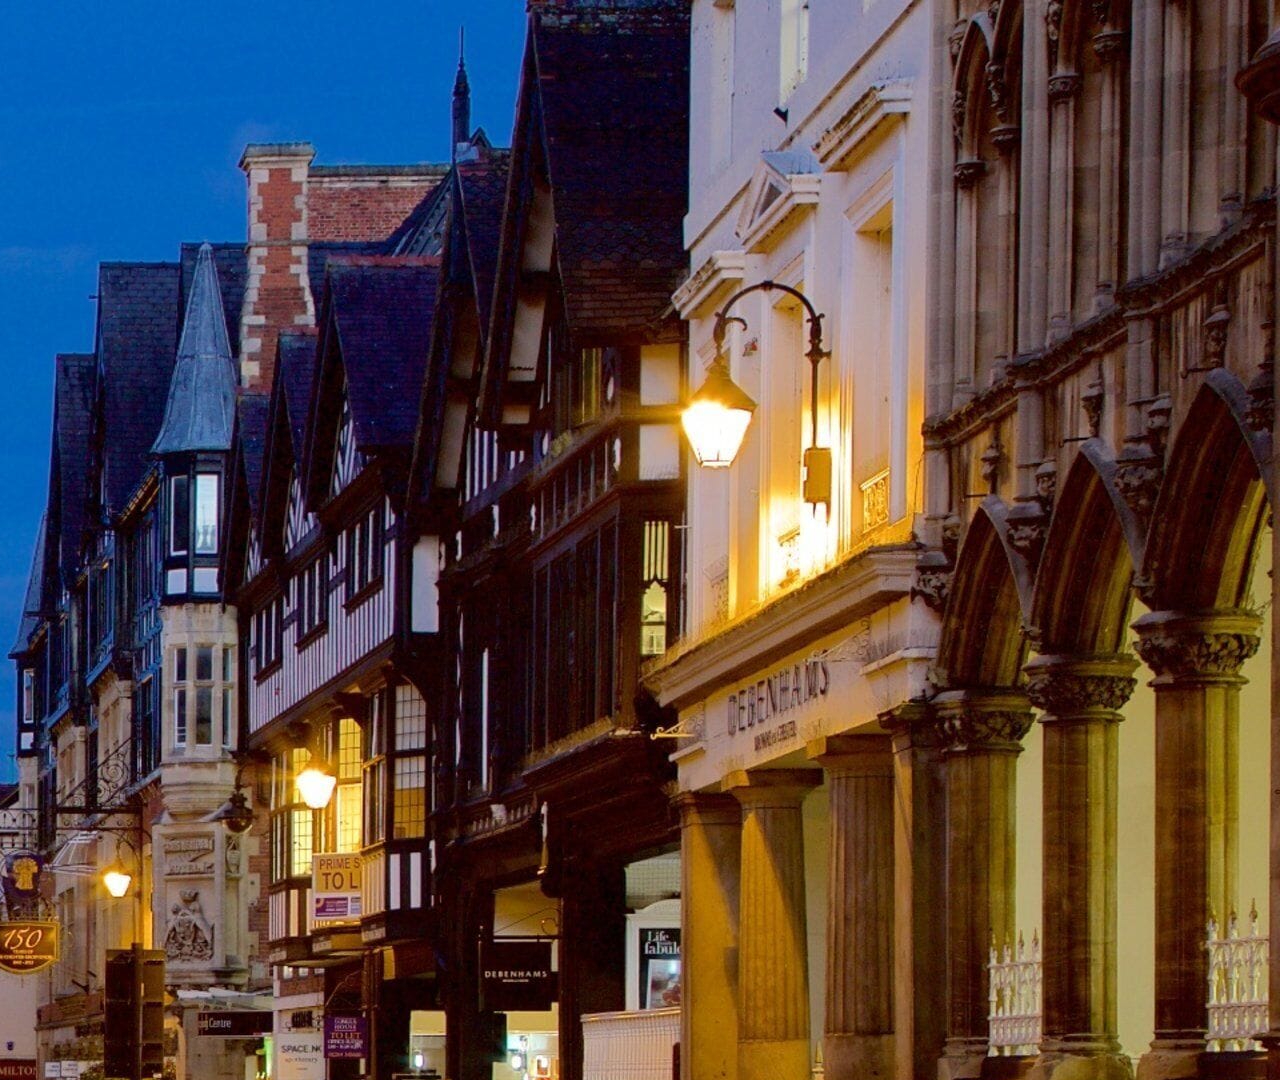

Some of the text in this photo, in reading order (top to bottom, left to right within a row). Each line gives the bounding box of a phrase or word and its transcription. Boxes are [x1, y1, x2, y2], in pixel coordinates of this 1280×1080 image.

[727, 658, 830, 736] DEBENHAMS
[320, 858, 351, 869] PRIME
[322, 872, 344, 890] TO
[4, 926, 43, 950] 150
[647, 931, 669, 941] Life
[484, 970, 548, 978] DEBENHAMS
[209, 1017, 232, 1028] Centre
